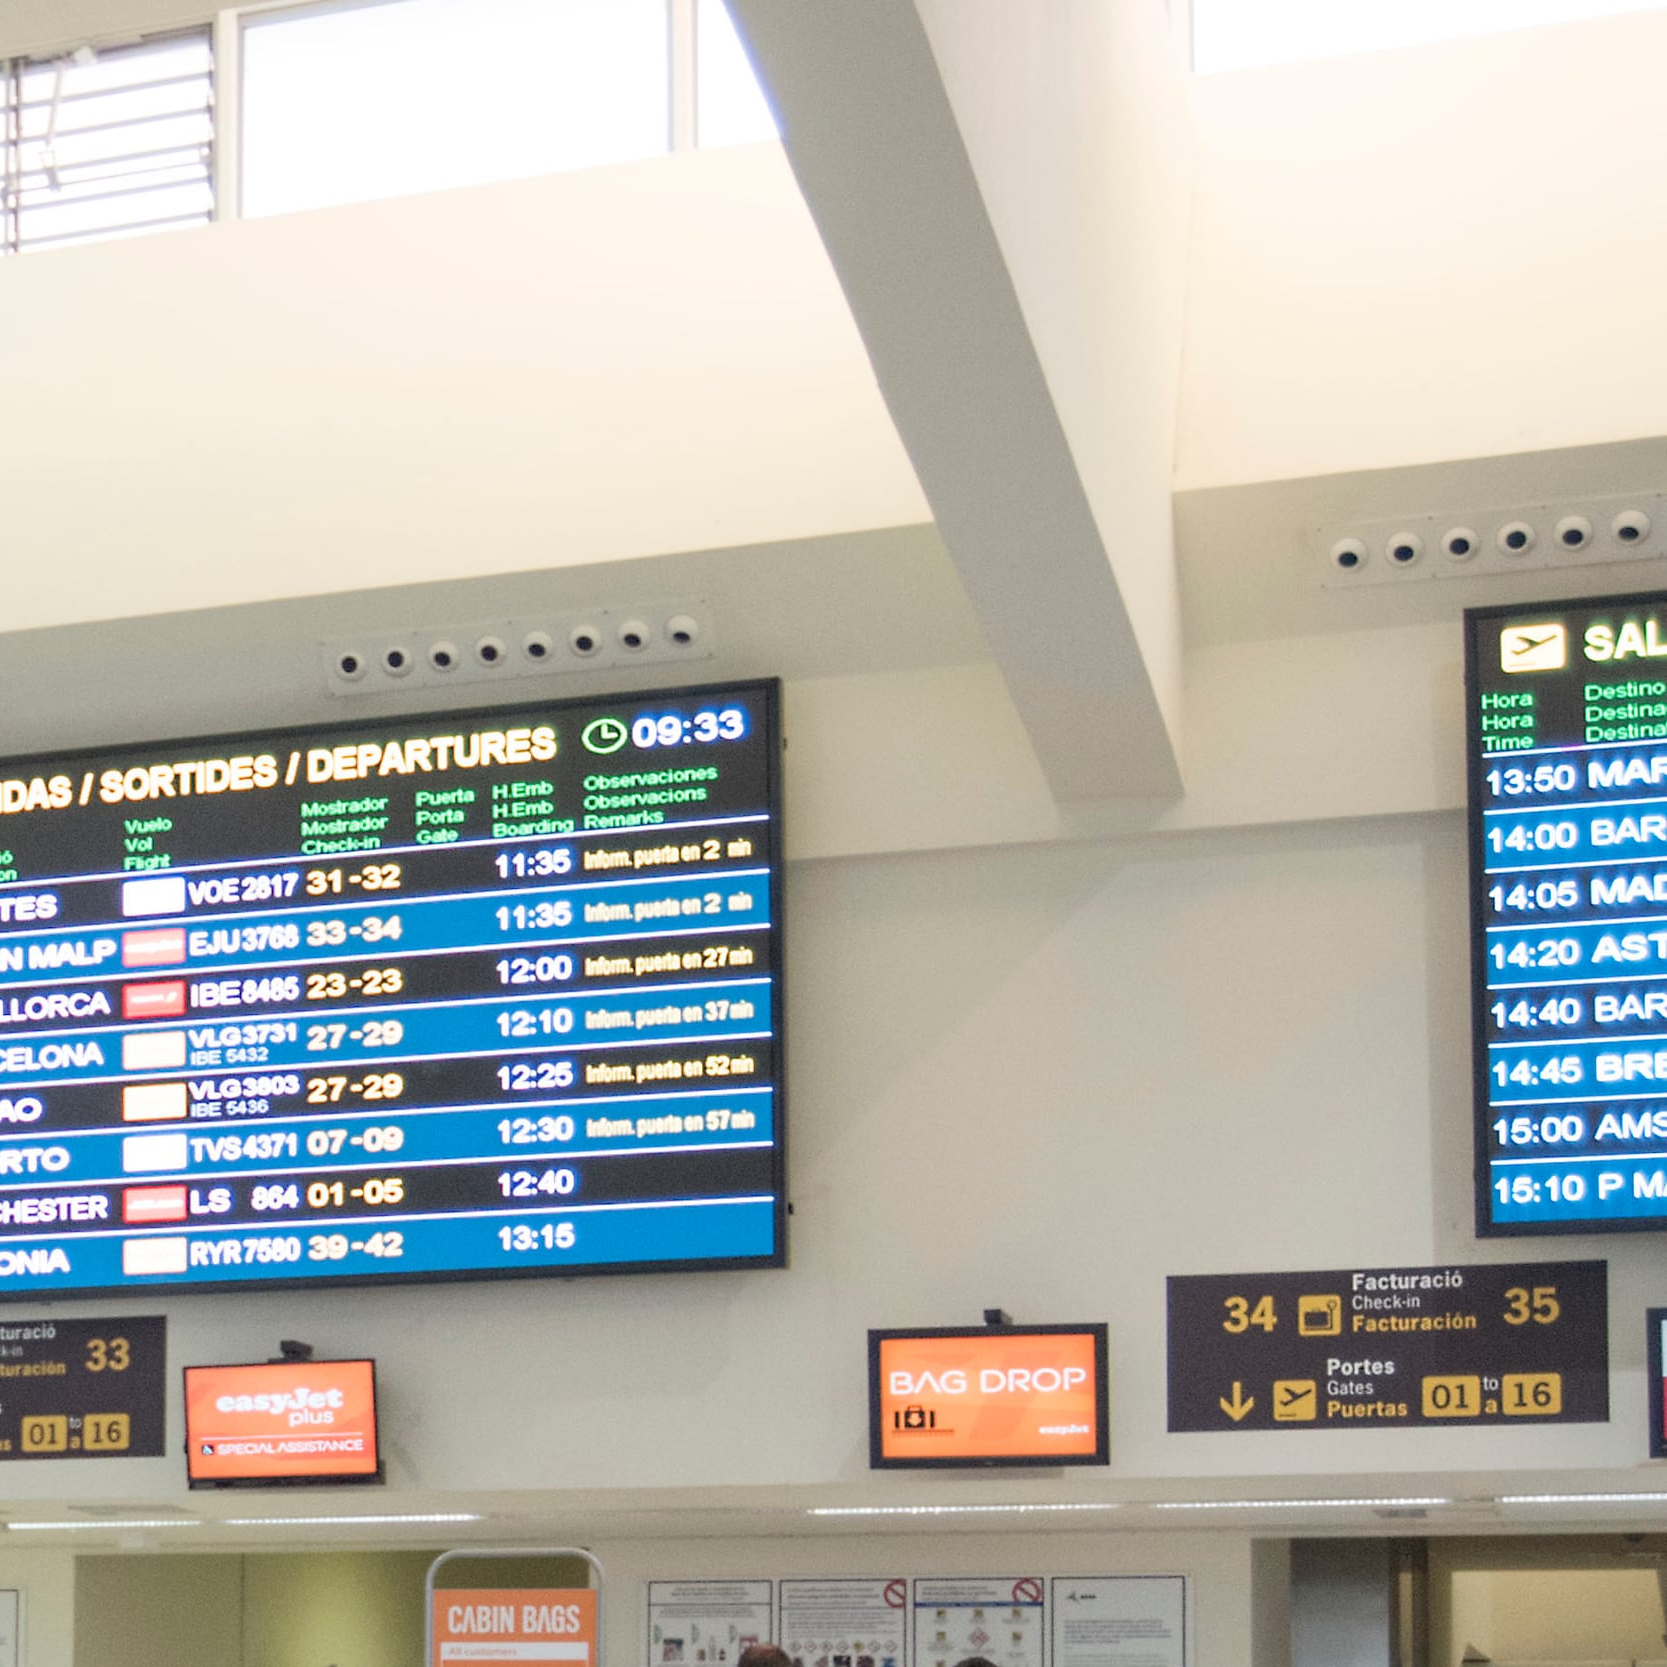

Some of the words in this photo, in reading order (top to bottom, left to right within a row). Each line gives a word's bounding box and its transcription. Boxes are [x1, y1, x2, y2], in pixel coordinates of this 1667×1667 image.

[1481, 692, 1535, 710] Hora
[1481, 713, 1536, 731] Hora
[97, 753, 280, 805] SORTIDES
[305, 724, 559, 785] DEPARTURES
[631, 708, 745, 750] 09:33
[1482, 735, 1533, 751] Time
[1487, 764, 1577, 795] 13:50
[122, 815, 174, 836] Vuelo
[299, 795, 390, 819] Mostrador
[414, 786, 477, 808] Puerta
[490, 778, 555, 801] H.Emb
[582, 765, 720, 793] Observaciones
[122, 835, 155, 854] Vol
[299, 814, 390, 838] Mostrador
[413, 806, 468, 828] Porta
[490, 797, 557, 820] H.Emb
[581, 784, 710, 812] Observacions
[122, 852, 172, 872] Flight
[299, 834, 383, 857] Check-in
[413, 825, 461, 846] Gate
[491, 816, 577, 840] Boarding
[581, 808, 667, 832] Remarks
[1488, 821, 1579, 853] 14:00
[493, 847, 573, 880] 11:35
[1489, 880, 1580, 911] 14:05
[27, 937, 119, 971] MALP
[494, 899, 574, 932] 11:35
[1490, 938, 1582, 969] 14:20
[494, 954, 573, 986] 12:00
[495, 1006, 575, 1038] 12:10
[1492, 998, 1582, 1028] 14:40
[495, 1060, 575, 1092] 12:25
[1493, 1056, 1584, 1086] 14:45
[496, 1114, 576, 1145] 12:30
[1494, 1115, 1584, 1145] 15:00
[496, 1168, 576, 1198] 12:40
[1495, 1174, 1587, 1204] 15:10
[497, 1221, 577, 1252] 13:15
[1353, 1271, 1462, 1291] Facturació
[1223, 1296, 1277, 1333] 34
[1353, 1313, 1476, 1332] Facturación
[1504, 1287, 1560, 1325] 35
[1352, 1294, 1421, 1311] Check-in
[86, 1338, 130, 1372] 33
[1327, 1358, 1395, 1376] Portes
[890, 1369, 968, 1395] BAG
[979, 1367, 1086, 1394] DROP
[1327, 1380, 1374, 1396] Gates
[1483, 1376, 1499, 1390] to
[216, 1387, 343, 1416] easyJet
[1327, 1400, 1408, 1417] Puertas
[1432, 1384, 1468, 1409] 01
[1485, 1399, 1497, 1414] a
[1514, 1382, 1551, 1408] 16
[289, 1409, 334, 1428] plus
[29, 1423, 57, 1446] 01
[70, 1437, 80, 1449] a
[93, 1421, 122, 1444] 16
[217, 1443, 277, 1455] SPECIAL
[277, 1438, 364, 1453] ASSISTANCE
[448, 1606, 514, 1633] CABIN
[522, 1605, 580, 1633] BAGS
